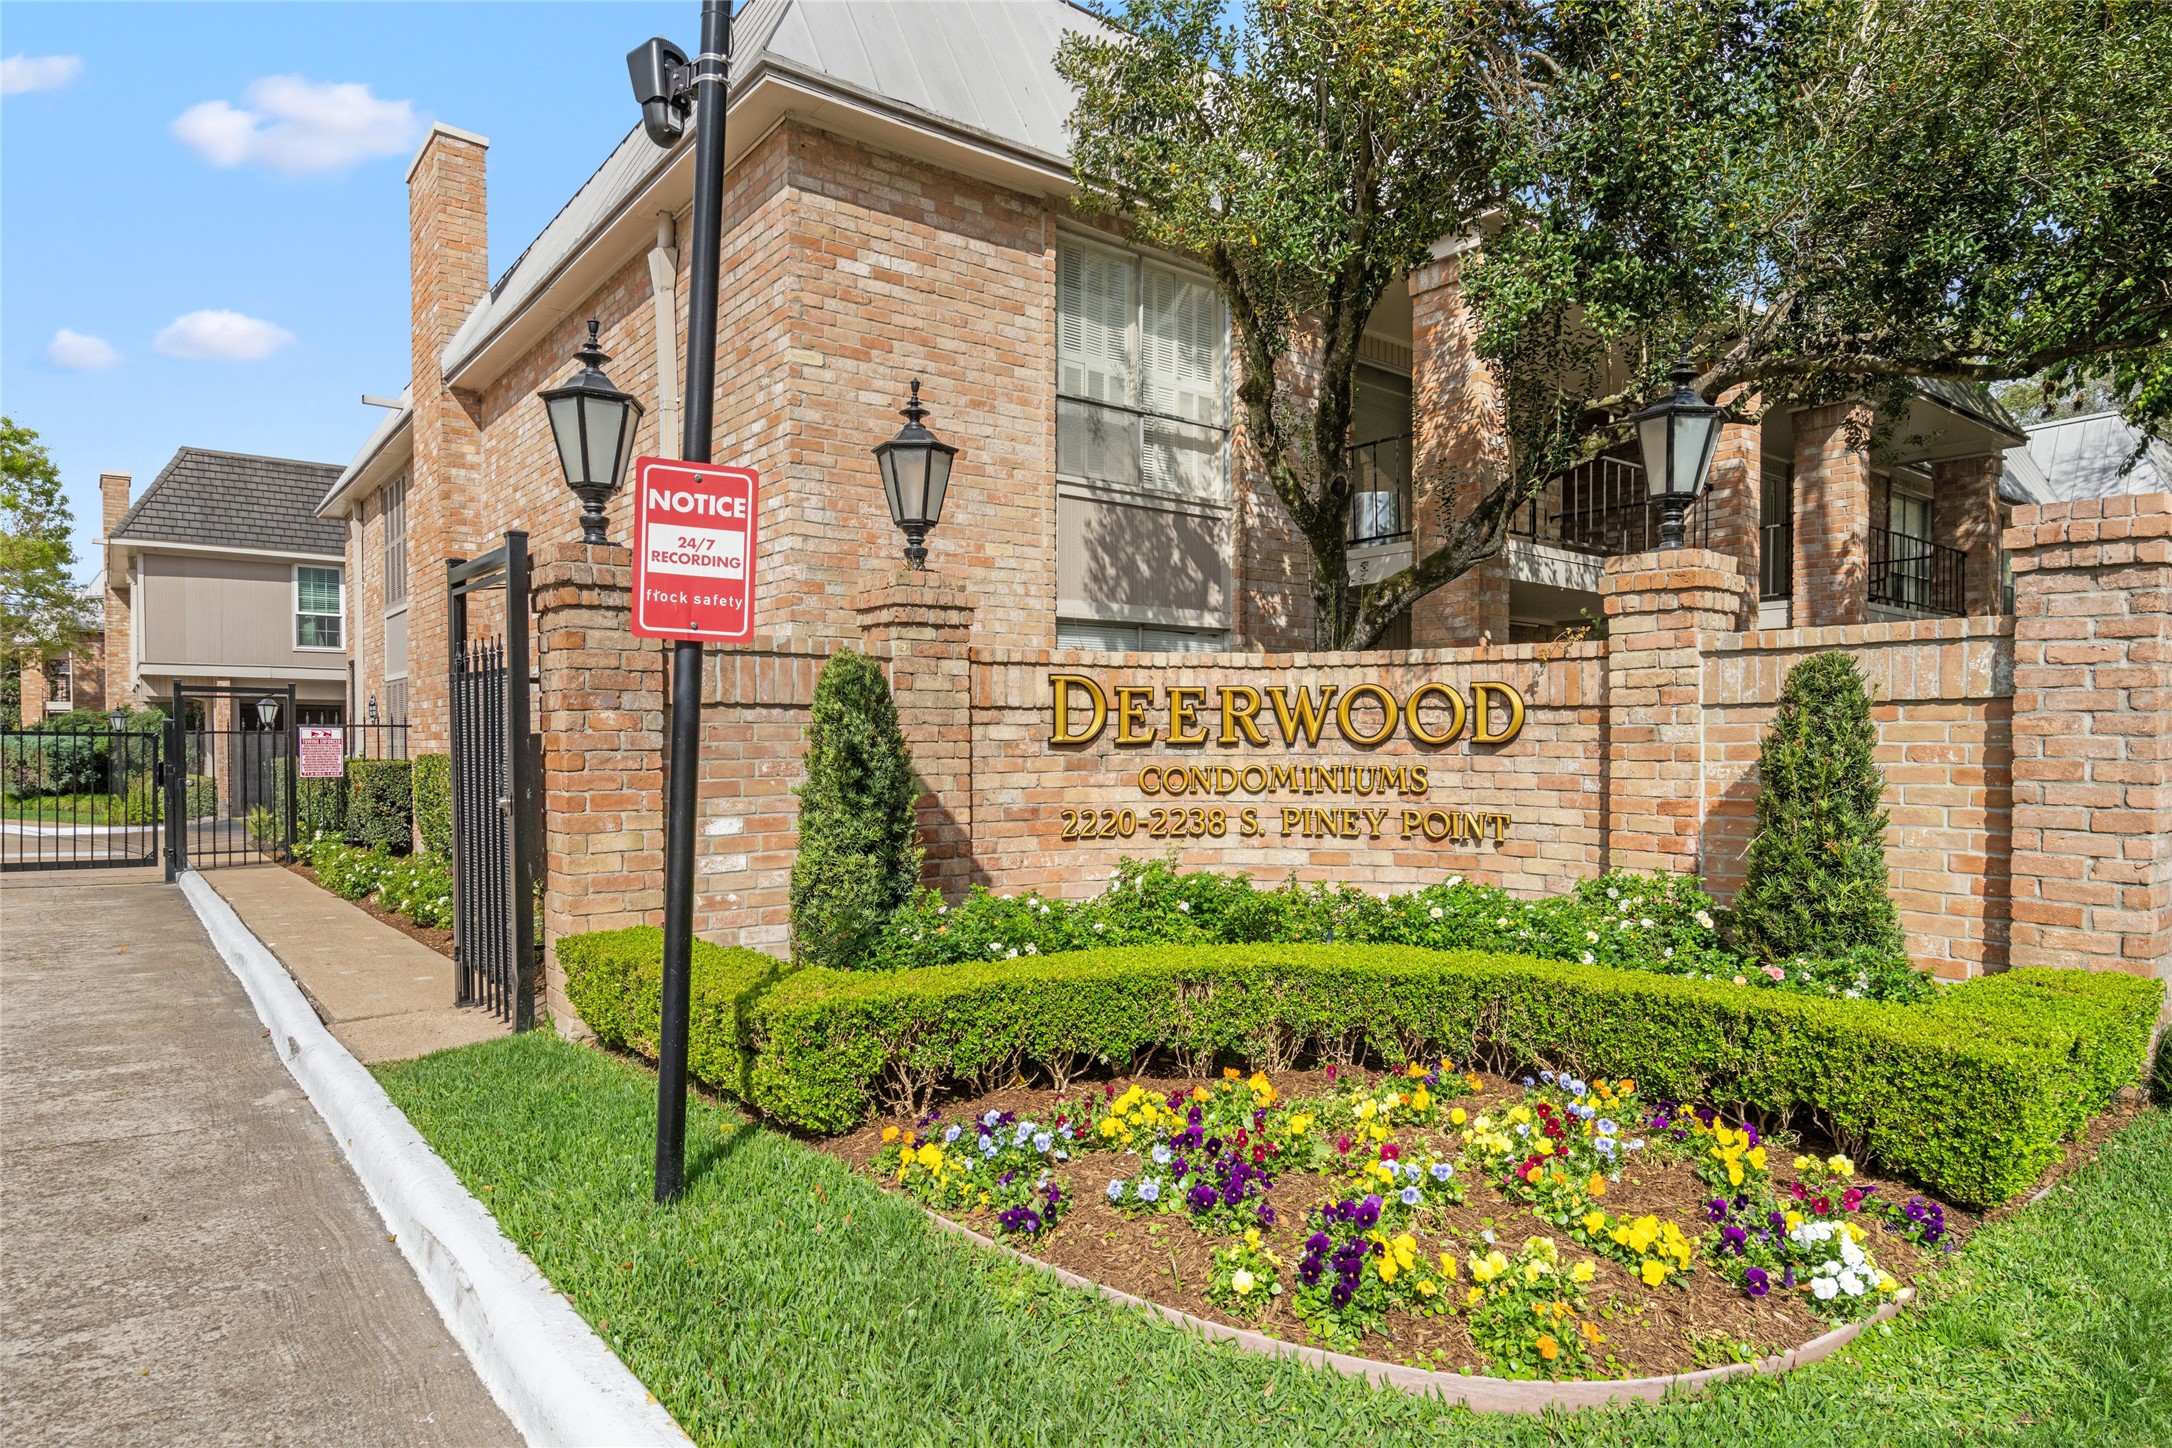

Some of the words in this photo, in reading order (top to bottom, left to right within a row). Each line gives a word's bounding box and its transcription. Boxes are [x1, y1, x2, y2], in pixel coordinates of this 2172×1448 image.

[649, 488, 746, 518] NOTICE
[677, 536, 716, 552] 24/7
[651, 550, 741, 569] RECORDING
[693, 594, 743, 610] safety
[1048, 673, 1527, 745] DEERWOOD
[1138, 764, 1429, 796] CONDOMINIUMS
[1060, 807, 1227, 839] 2220-2238
[1240, 807, 1266, 838] S.
[1281, 807, 1388, 839] PINEY
[1401, 808, 1511, 843] POINT
